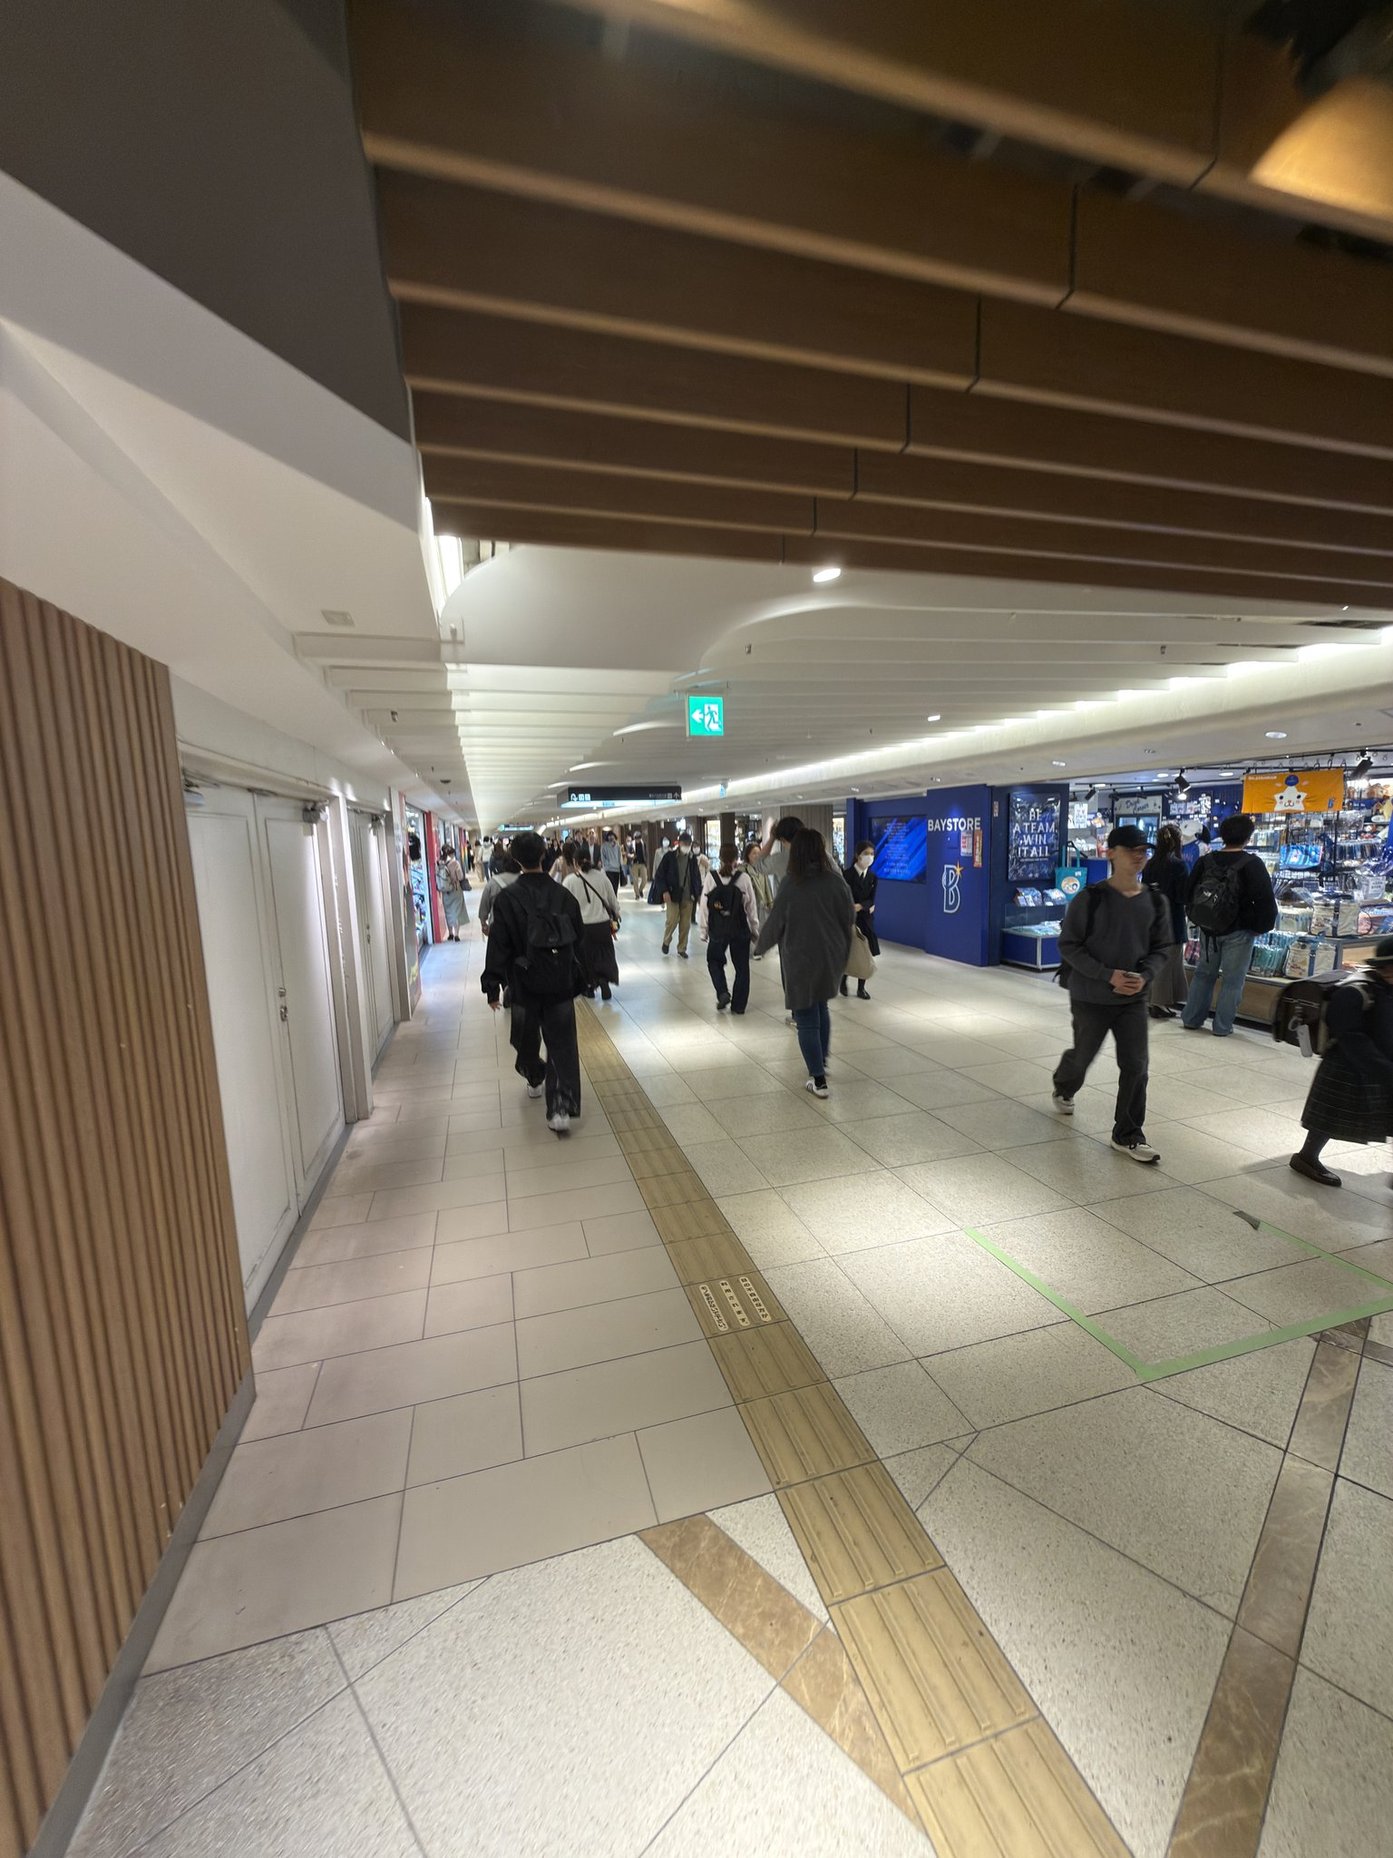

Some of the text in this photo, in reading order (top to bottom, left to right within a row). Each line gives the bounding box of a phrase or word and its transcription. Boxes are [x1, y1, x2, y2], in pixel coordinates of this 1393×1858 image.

[1029, 808, 1041, 821] BE
[927, 817, 981, 832] BAYSTORE
[1013, 822, 1022, 834] A
[1023, 834, 1047, 846] WIN
[1018, 846, 1029, 858] IT
